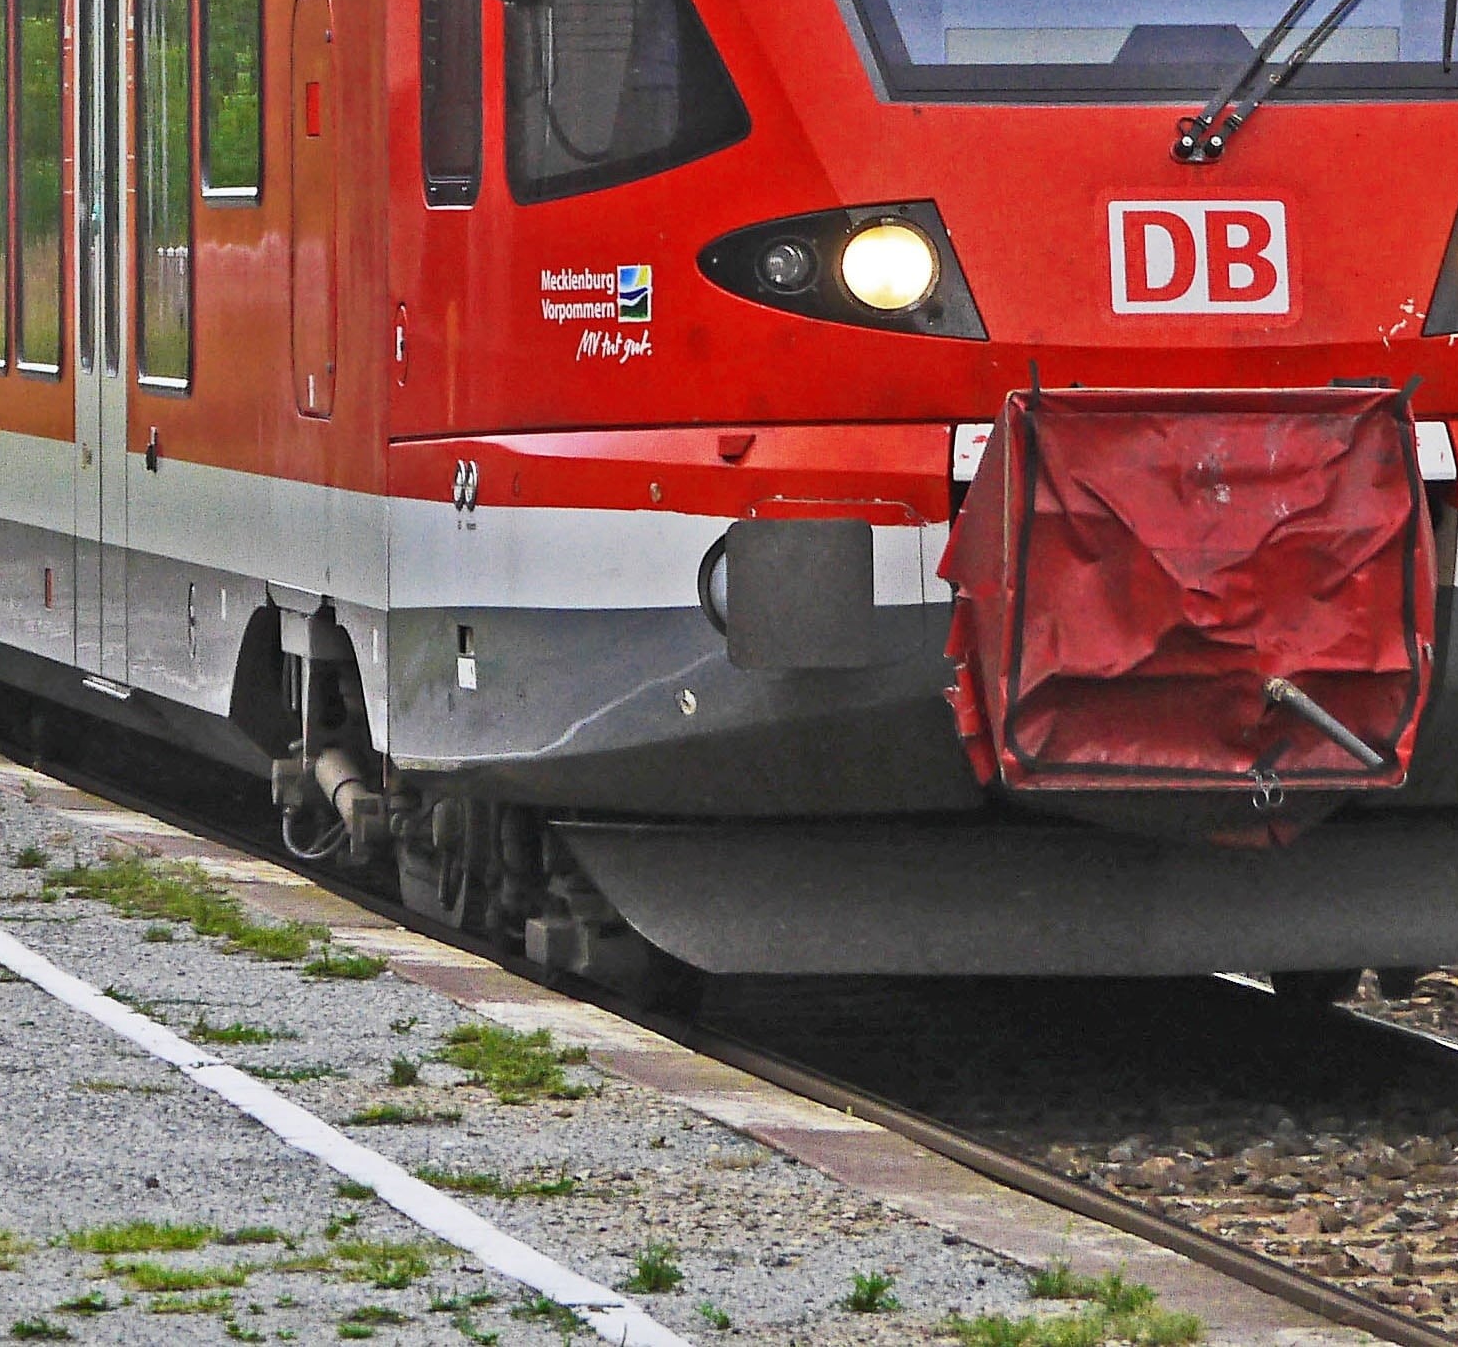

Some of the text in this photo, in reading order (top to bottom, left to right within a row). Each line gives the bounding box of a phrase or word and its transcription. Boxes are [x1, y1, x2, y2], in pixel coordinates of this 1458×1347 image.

[1122, 210, 1278, 302] DB
[541, 268, 615, 295] Mecklenburg
[541, 298, 615, 325] Vorpommern
[576, 328, 602, 361] MV
[601, 331, 623, 359] tut
